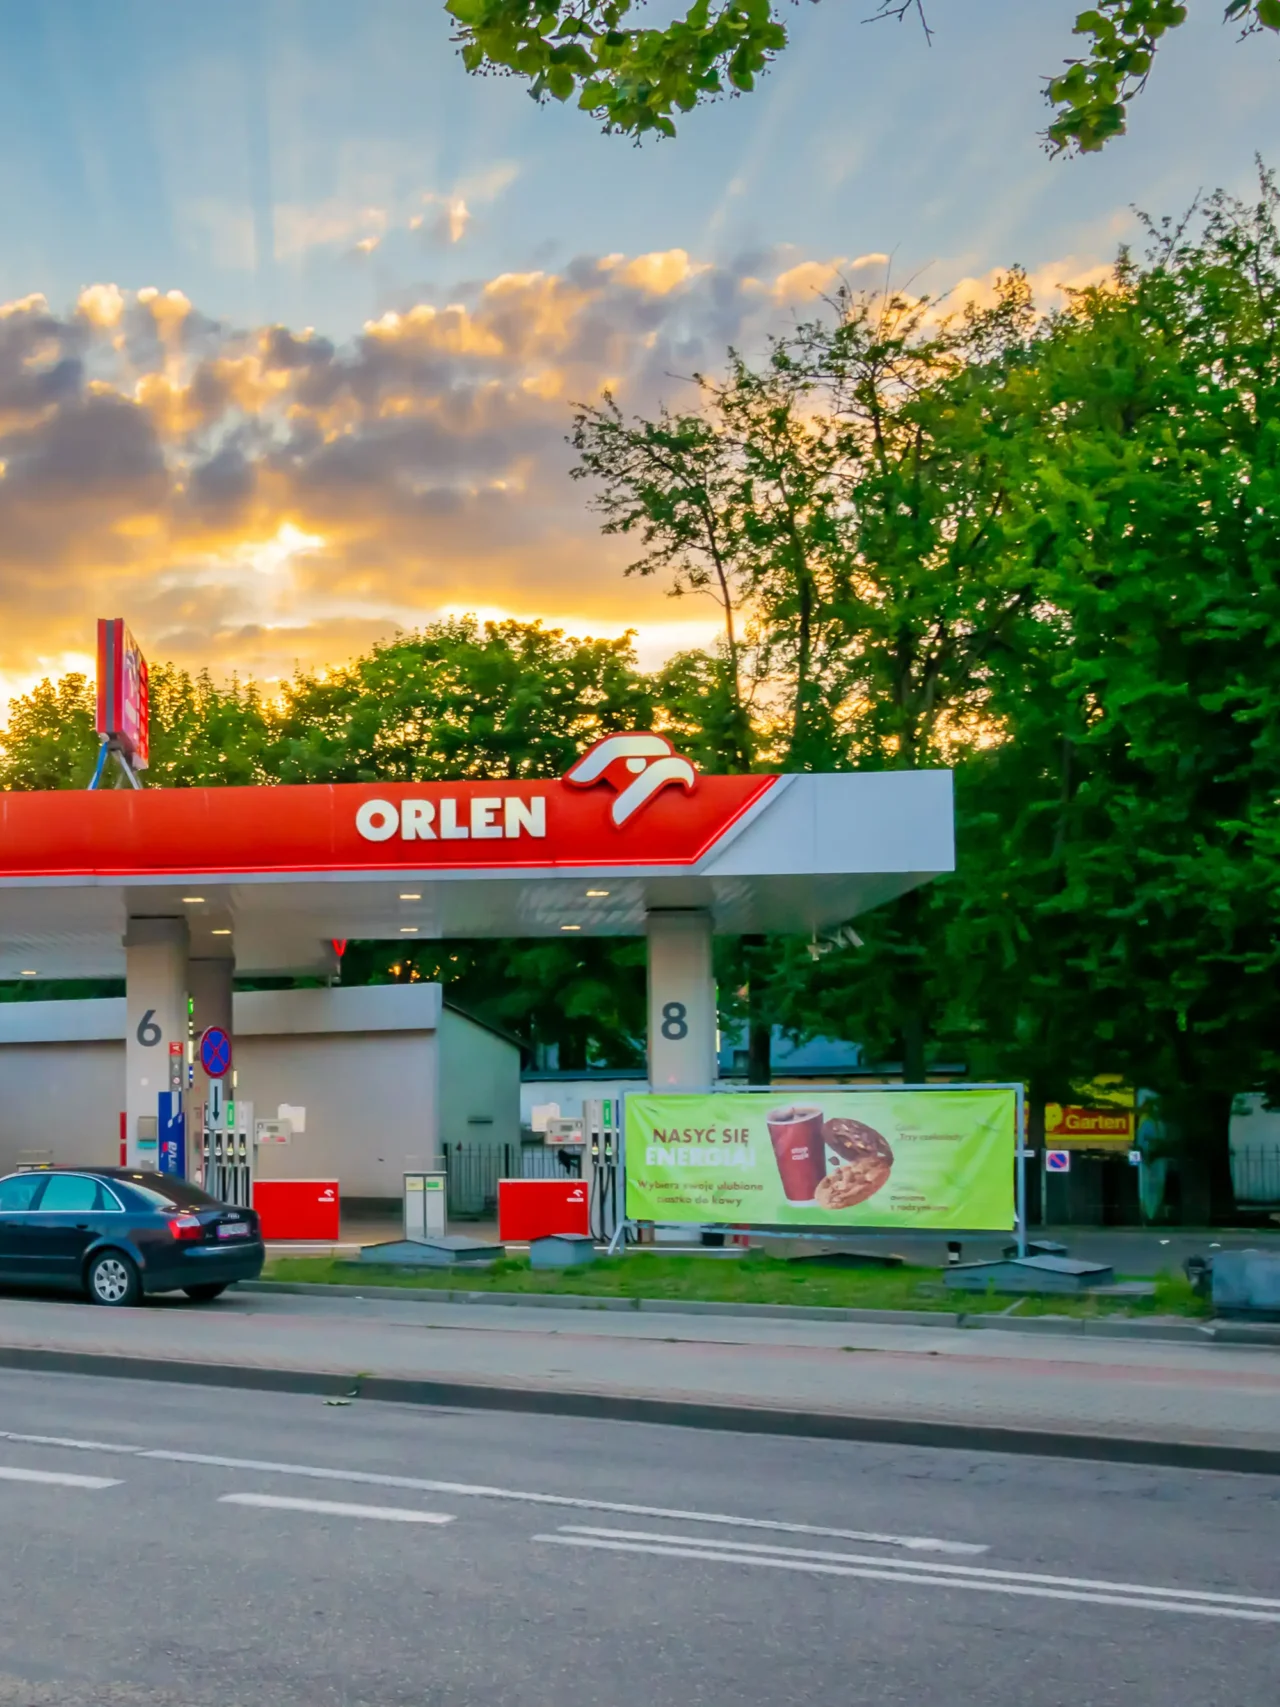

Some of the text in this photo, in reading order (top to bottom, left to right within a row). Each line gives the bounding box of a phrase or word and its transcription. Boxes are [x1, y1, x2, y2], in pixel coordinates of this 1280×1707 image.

[355, 796, 546, 842] ORLEN
[136, 1009, 162, 1047] 6
[661, 1001, 688, 1040] 8
[653, 1124, 749, 1147] NASYĆ SIĘ
[1065, 1114, 1126, 1130] Garten
